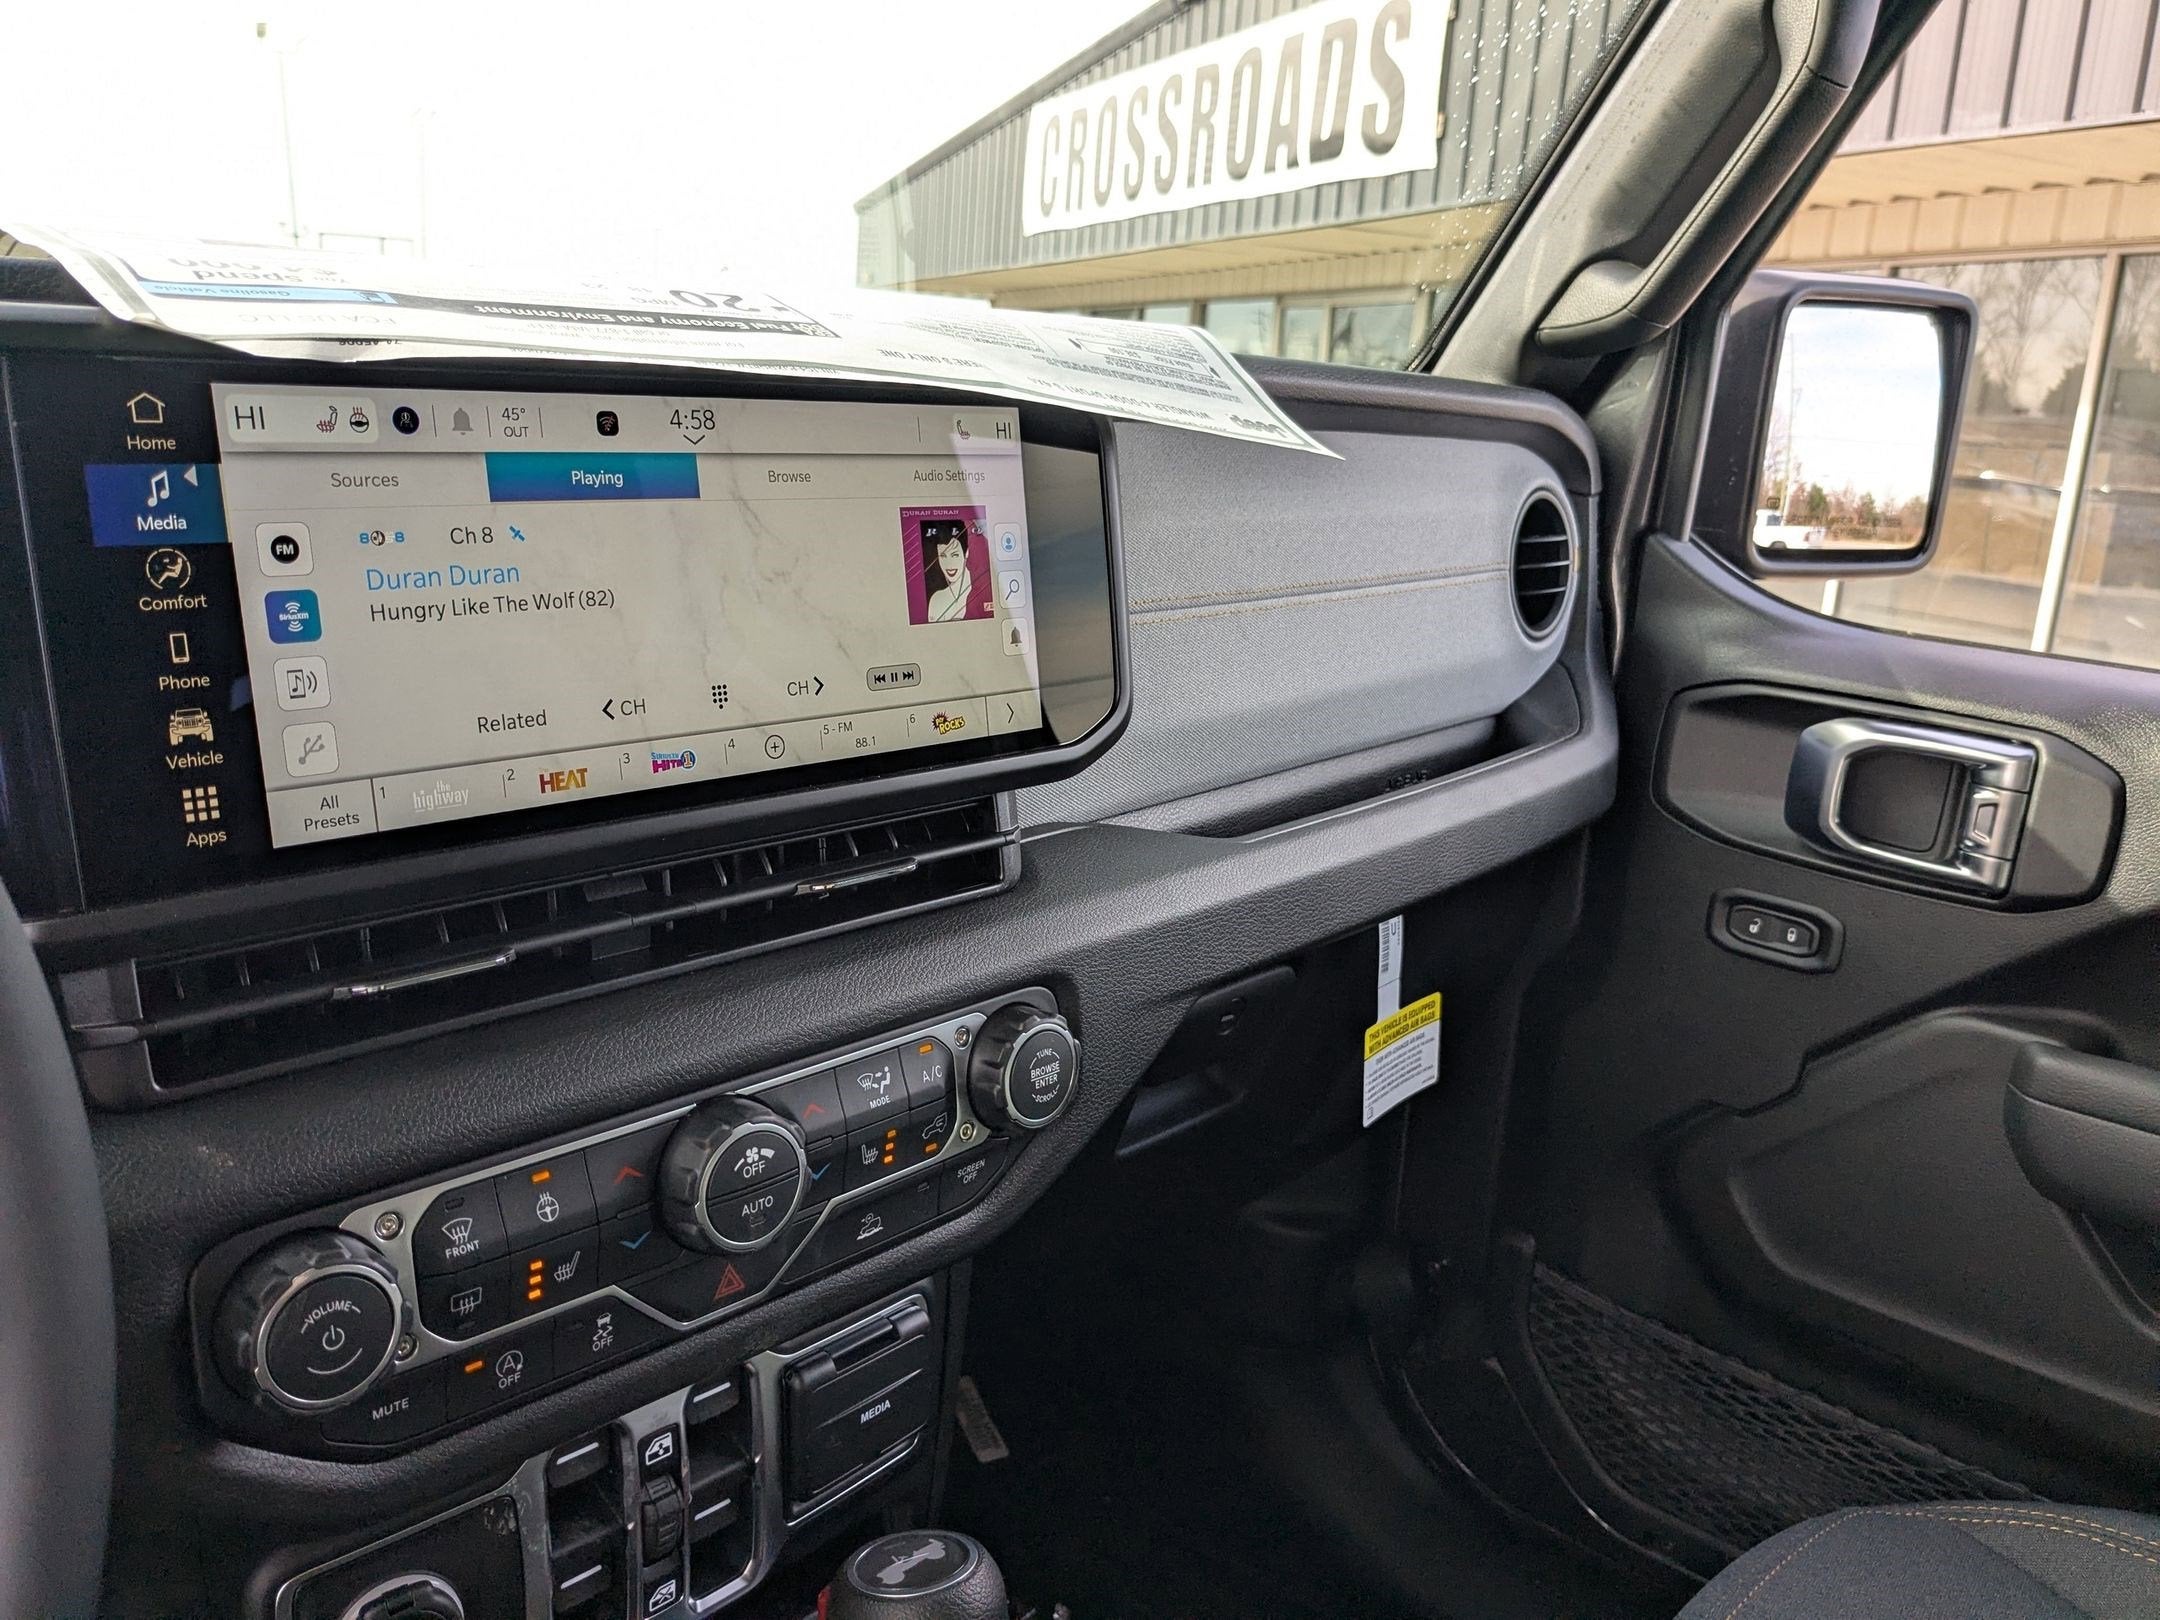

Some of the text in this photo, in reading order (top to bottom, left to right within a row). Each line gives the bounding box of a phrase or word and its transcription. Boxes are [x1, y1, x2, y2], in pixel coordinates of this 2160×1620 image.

[1040, 0, 1411, 218] CROSSROADS
[193, 268, 303, 284] spend
[154, 284, 291, 298] Gasoline Vehicle
[670, 289, 761, 313] 20
[474, 306, 791, 332] Fuel Economy and Environment
[234, 406, 265, 431] HI
[501, 407, 526, 421] 45°
[670, 409, 716, 431] 4:58
[503, 426, 529, 438] OUT
[996, 422, 1012, 439] HI
[127, 435, 176, 451] Home
[331, 473, 399, 488] Sources
[571, 469, 624, 488] Playing
[768, 469, 811, 484] Browse
[913, 468, 985, 486] Audio Settings
[137, 515, 187, 531] Media
[450, 527, 494, 545] Ch 8
[275, 544, 295, 556] FM
[366, 564, 520, 592] Duran Duran
[139, 594, 207, 610] Comfort
[370, 588, 616, 623] Hungry Like The Wolf (82)
[159, 673, 210, 691] Phone
[787, 680, 810, 697] CH
[620, 698, 647, 717] CH
[477, 710, 548, 733] Related
[909, 713, 916, 724] 6
[938, 716, 966, 735] ROCKS
[823, 724, 830, 735] 5
[838, 721, 853, 733] FM
[728, 738, 736, 749] 4
[855, 736, 877, 749] 88.1
[166, 751, 224, 769] Vehicle
[622, 753, 631, 765] 3
[507, 769, 516, 782] 2
[538, 768, 588, 795] HEAT
[379, 787, 387, 800] 1
[413, 787, 469, 812] highway
[320, 795, 339, 811] All
[303, 810, 360, 832] Presets
[186, 830, 227, 848] Apps
[1380, 1016, 1403, 1034] VEHICLE
[1409, 1000, 1436, 1018] EQUIPPED
[1382, 1023, 1410, 1046] ADVANCED
[1036, 1048, 1053, 1059] TUNE
[922, 1065, 943, 1083] A/C
[1030, 1060, 1060, 1079] BROWSE
[1035, 1074, 1058, 1090] ENTER
[869, 1095, 891, 1109] MODE
[1035, 1090, 1057, 1103] SCROLL
[742, 1159, 767, 1179] OFF
[957, 1158, 985, 1179] SCREEN
[963, 1170, 978, 1185] OFF
[741, 1195, 774, 1217] AUTO
[445, 1239, 481, 1259] FRONT
[304, 1300, 353, 1326] VOLUME
[592, 1335, 614, 1353] OFF
[498, 1371, 522, 1390] OFF
[372, 1398, 410, 1420] MUTE
[859, 1400, 891, 1424] MEDIA
